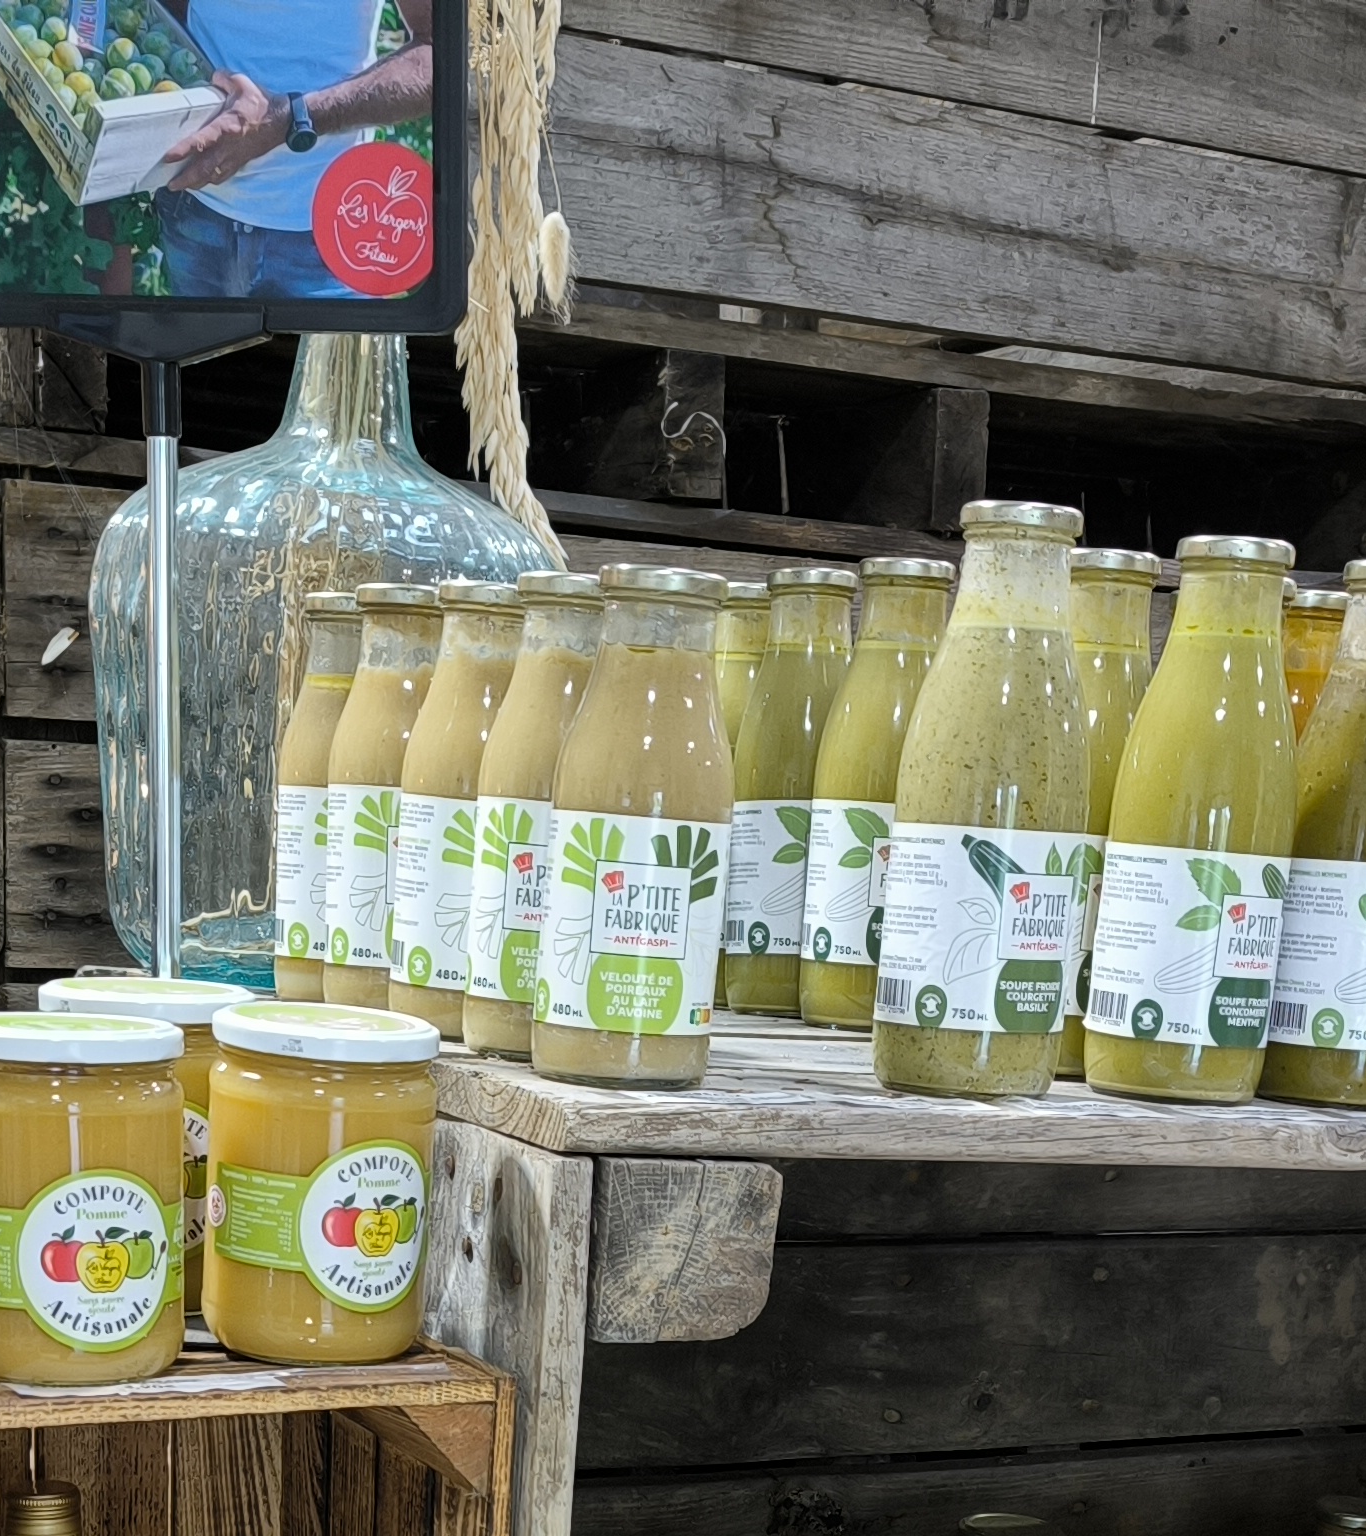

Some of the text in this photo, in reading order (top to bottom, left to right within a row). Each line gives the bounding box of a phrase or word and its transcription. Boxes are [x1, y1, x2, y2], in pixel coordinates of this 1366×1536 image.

[337, 194, 427, 243] Les Vergers
[355, 241, 398, 264] Fitou
[627, 884, 682, 912] P'TITE
[1032, 894, 1068, 917] P'TITE
[604, 909, 679, 934] FABRIQUE
[1012, 918, 1066, 939] FABRIQUE
[1228, 937, 1275, 959] FABRIQUE
[600, 972, 673, 987] VELOUTÉ DE
[606, 984, 666, 997] POIREAUX
[612, 995, 659, 1007] AU LAIT
[553, 1004, 570, 1016] 480
[607, 1006, 662, 1019] D'AVOINE
[951, 1008, 975, 1019] 750
[1167, 1022, 1190, 1033] 750
[337, 1155, 416, 1184] COMPOTE
[357, 1177, 401, 1189] Pomme
[53, 1186, 149, 1214] COMPOTE
[76, 1208, 128, 1221] Pomme
[320, 1260, 414, 1297] Artisanale
[42, 1296, 153, 1337] Artisanale
